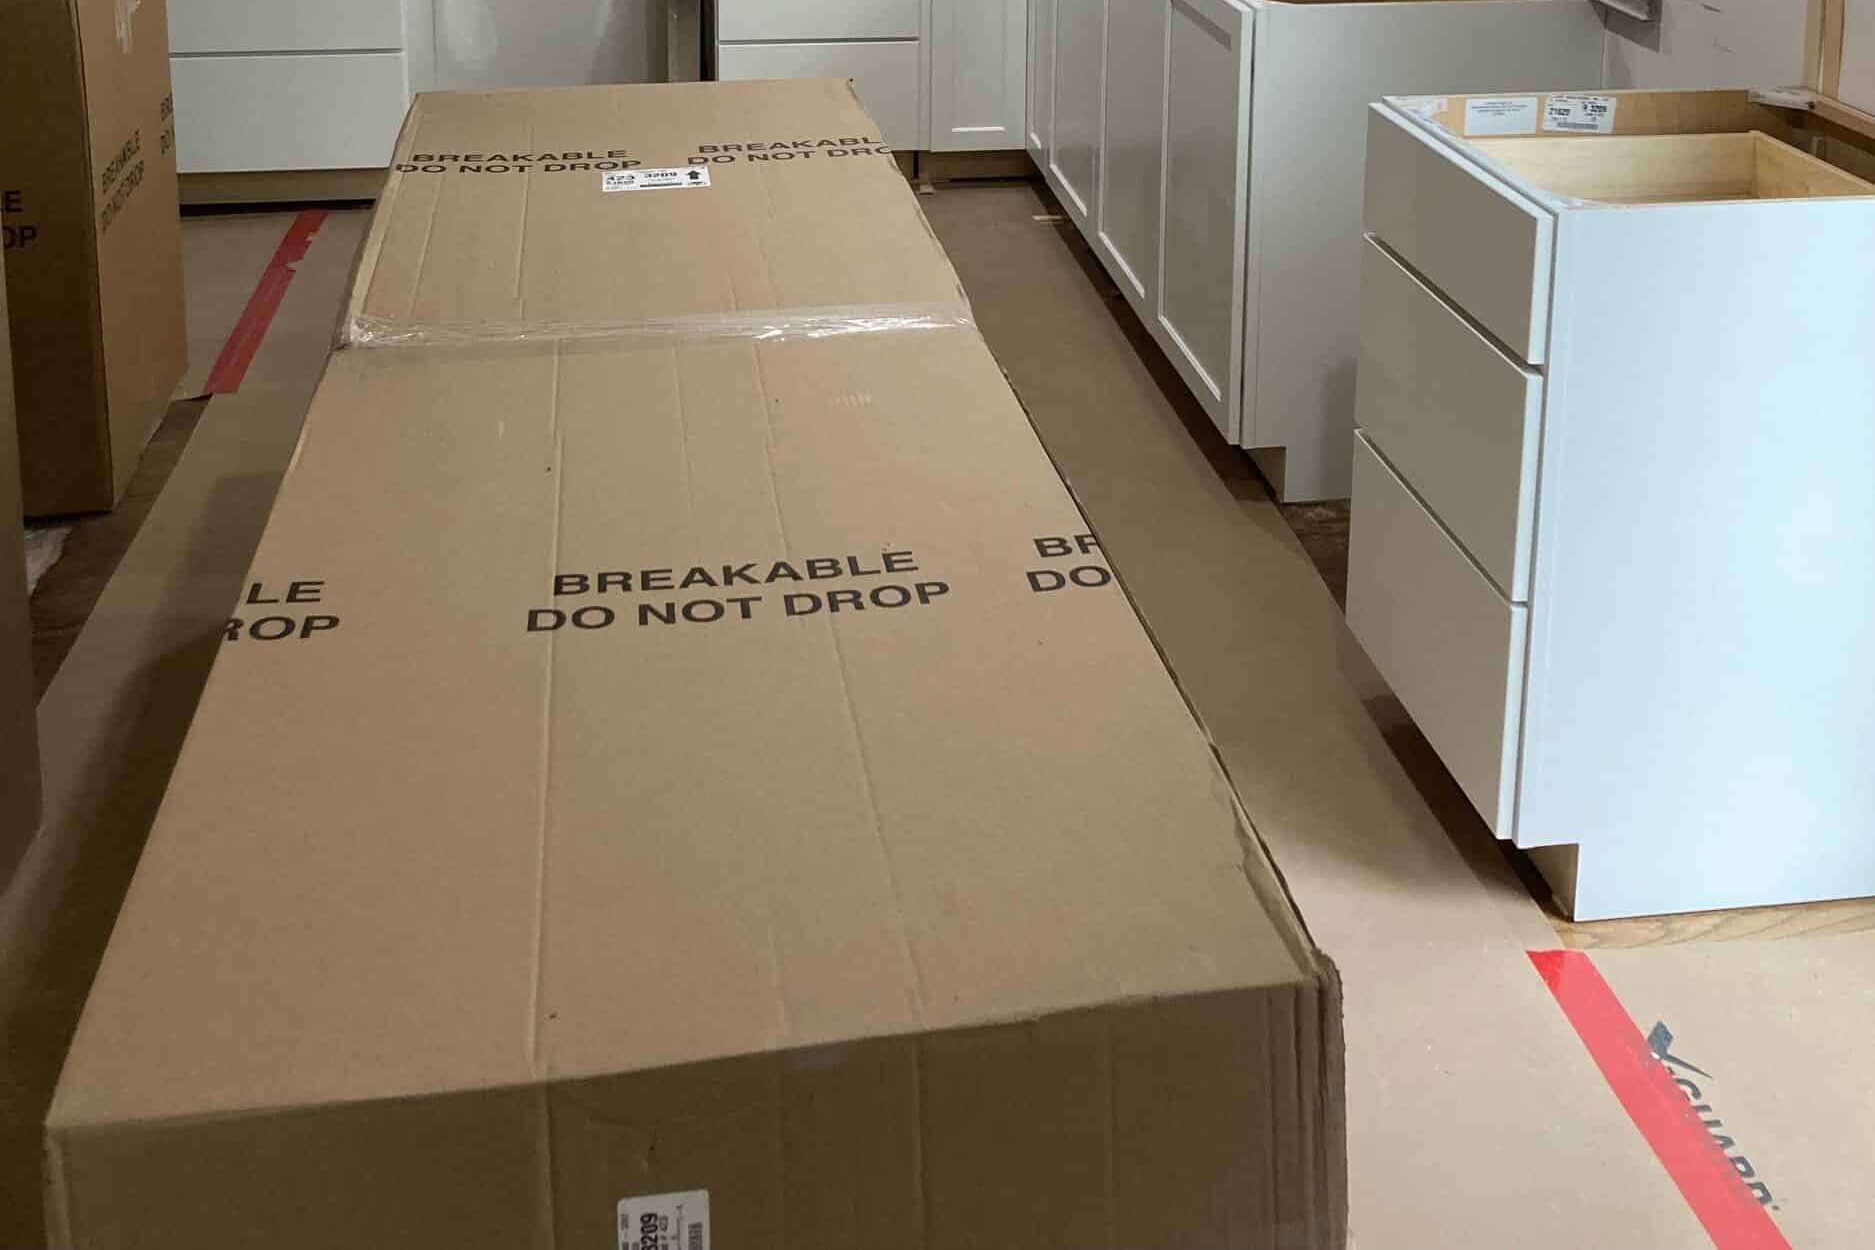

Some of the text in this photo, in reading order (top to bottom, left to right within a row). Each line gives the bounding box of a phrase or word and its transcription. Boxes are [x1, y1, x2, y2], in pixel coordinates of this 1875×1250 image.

[396, 160, 642, 174] DO NOT DROP
[413, 150, 628, 163] BREAKABLE
[687, 155, 736, 165] DO
[747, 150, 816, 162] NOT
[553, 551, 919, 597] BREAKABLE
[1026, 565, 1111, 593] DO
[526, 582, 949, 633] DO NOT DROP
